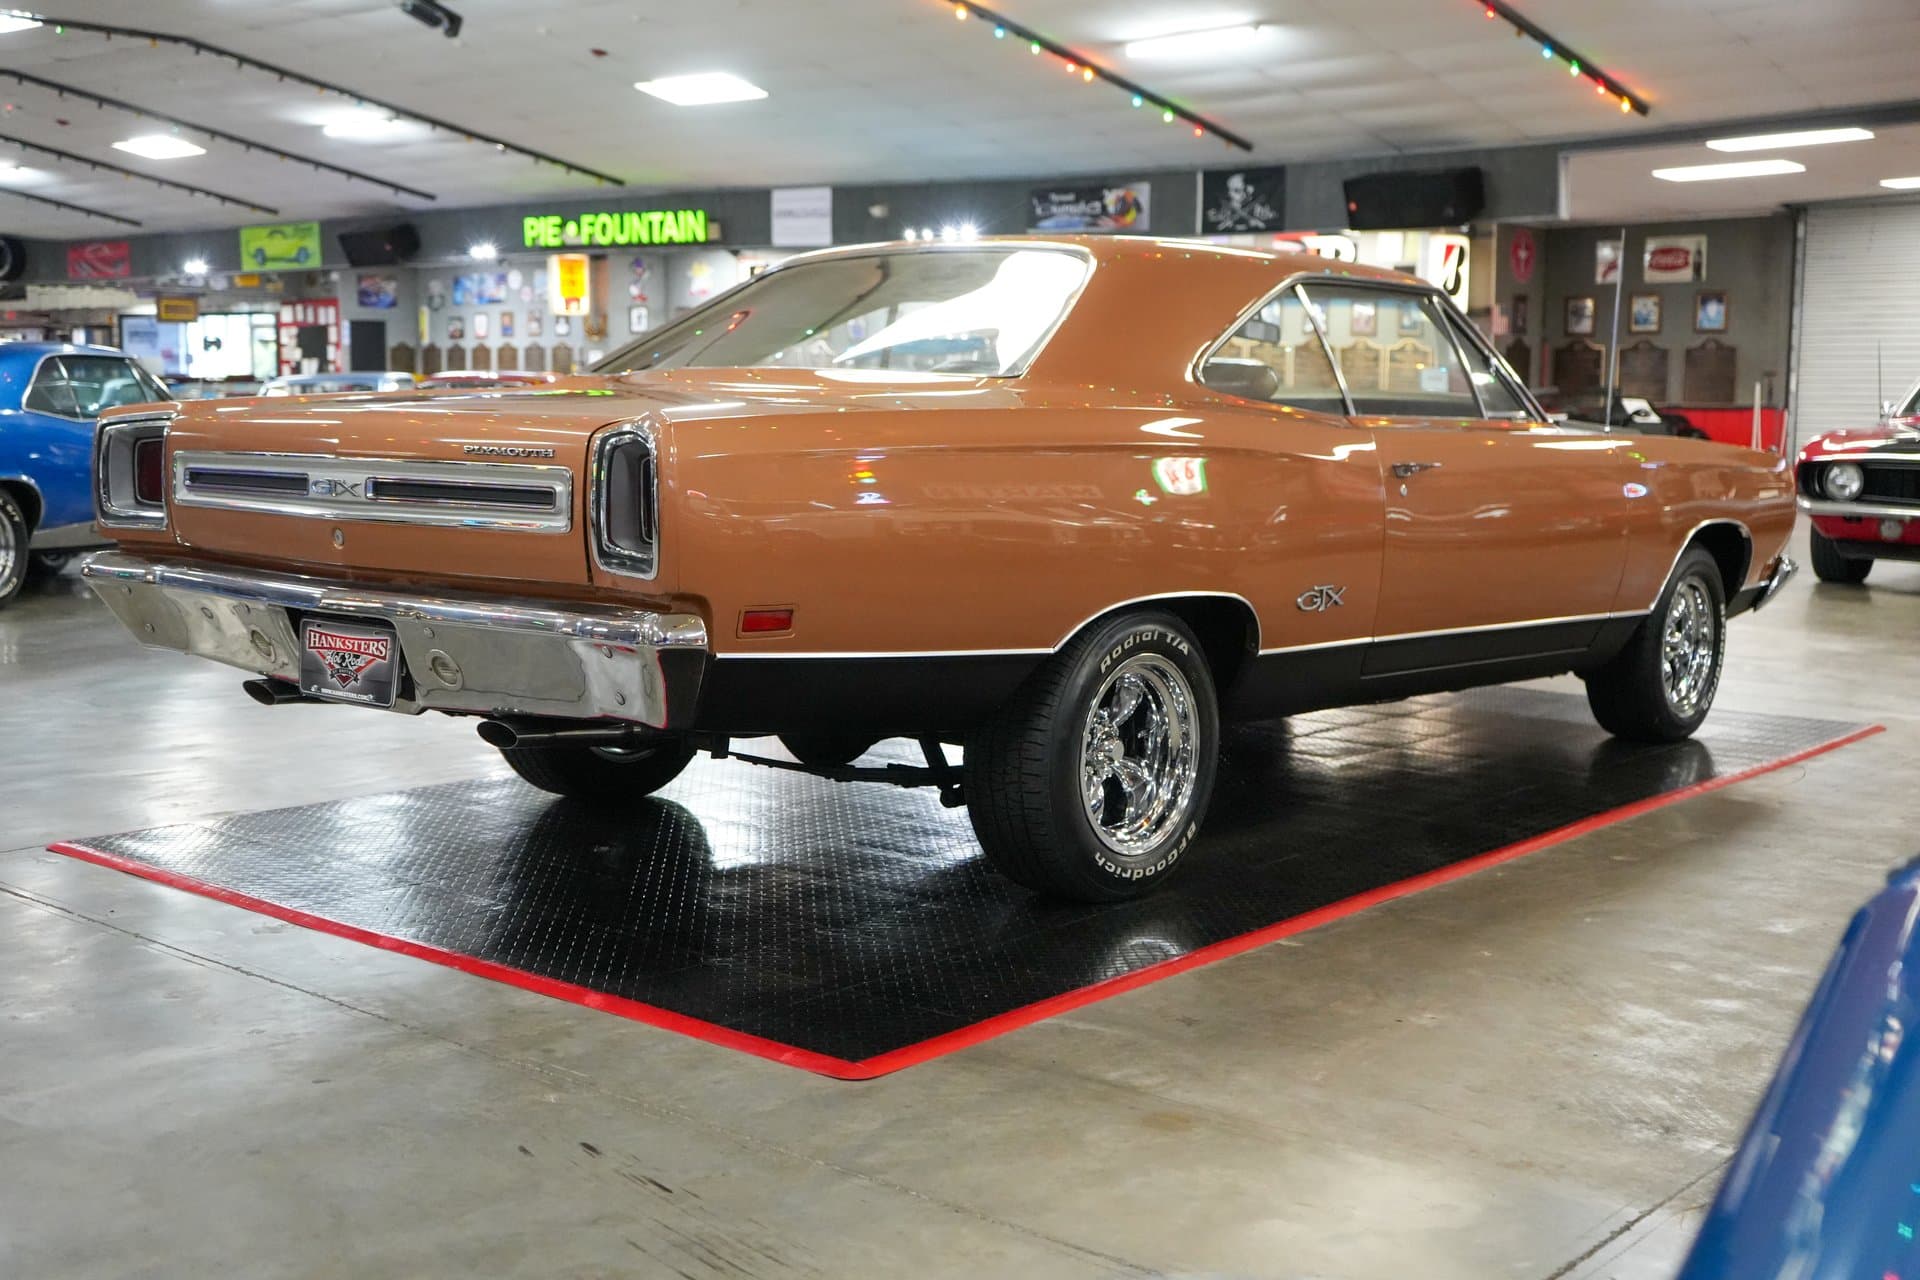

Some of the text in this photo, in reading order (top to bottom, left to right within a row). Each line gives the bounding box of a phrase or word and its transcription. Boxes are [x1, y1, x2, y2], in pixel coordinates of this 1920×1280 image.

[524, 210, 707, 247] PIE FOUNTAIN
[463, 445, 556, 458] PLYMOUTH
[311, 478, 361, 498] GTX
[1297, 585, 1346, 612] GTX
[309, 631, 387, 657] HANKSTERS
[1100, 629, 1190, 674] Radial T/A
[324, 650, 345, 665] Hot
[1094, 820, 1197, 881] BFGoodrich
